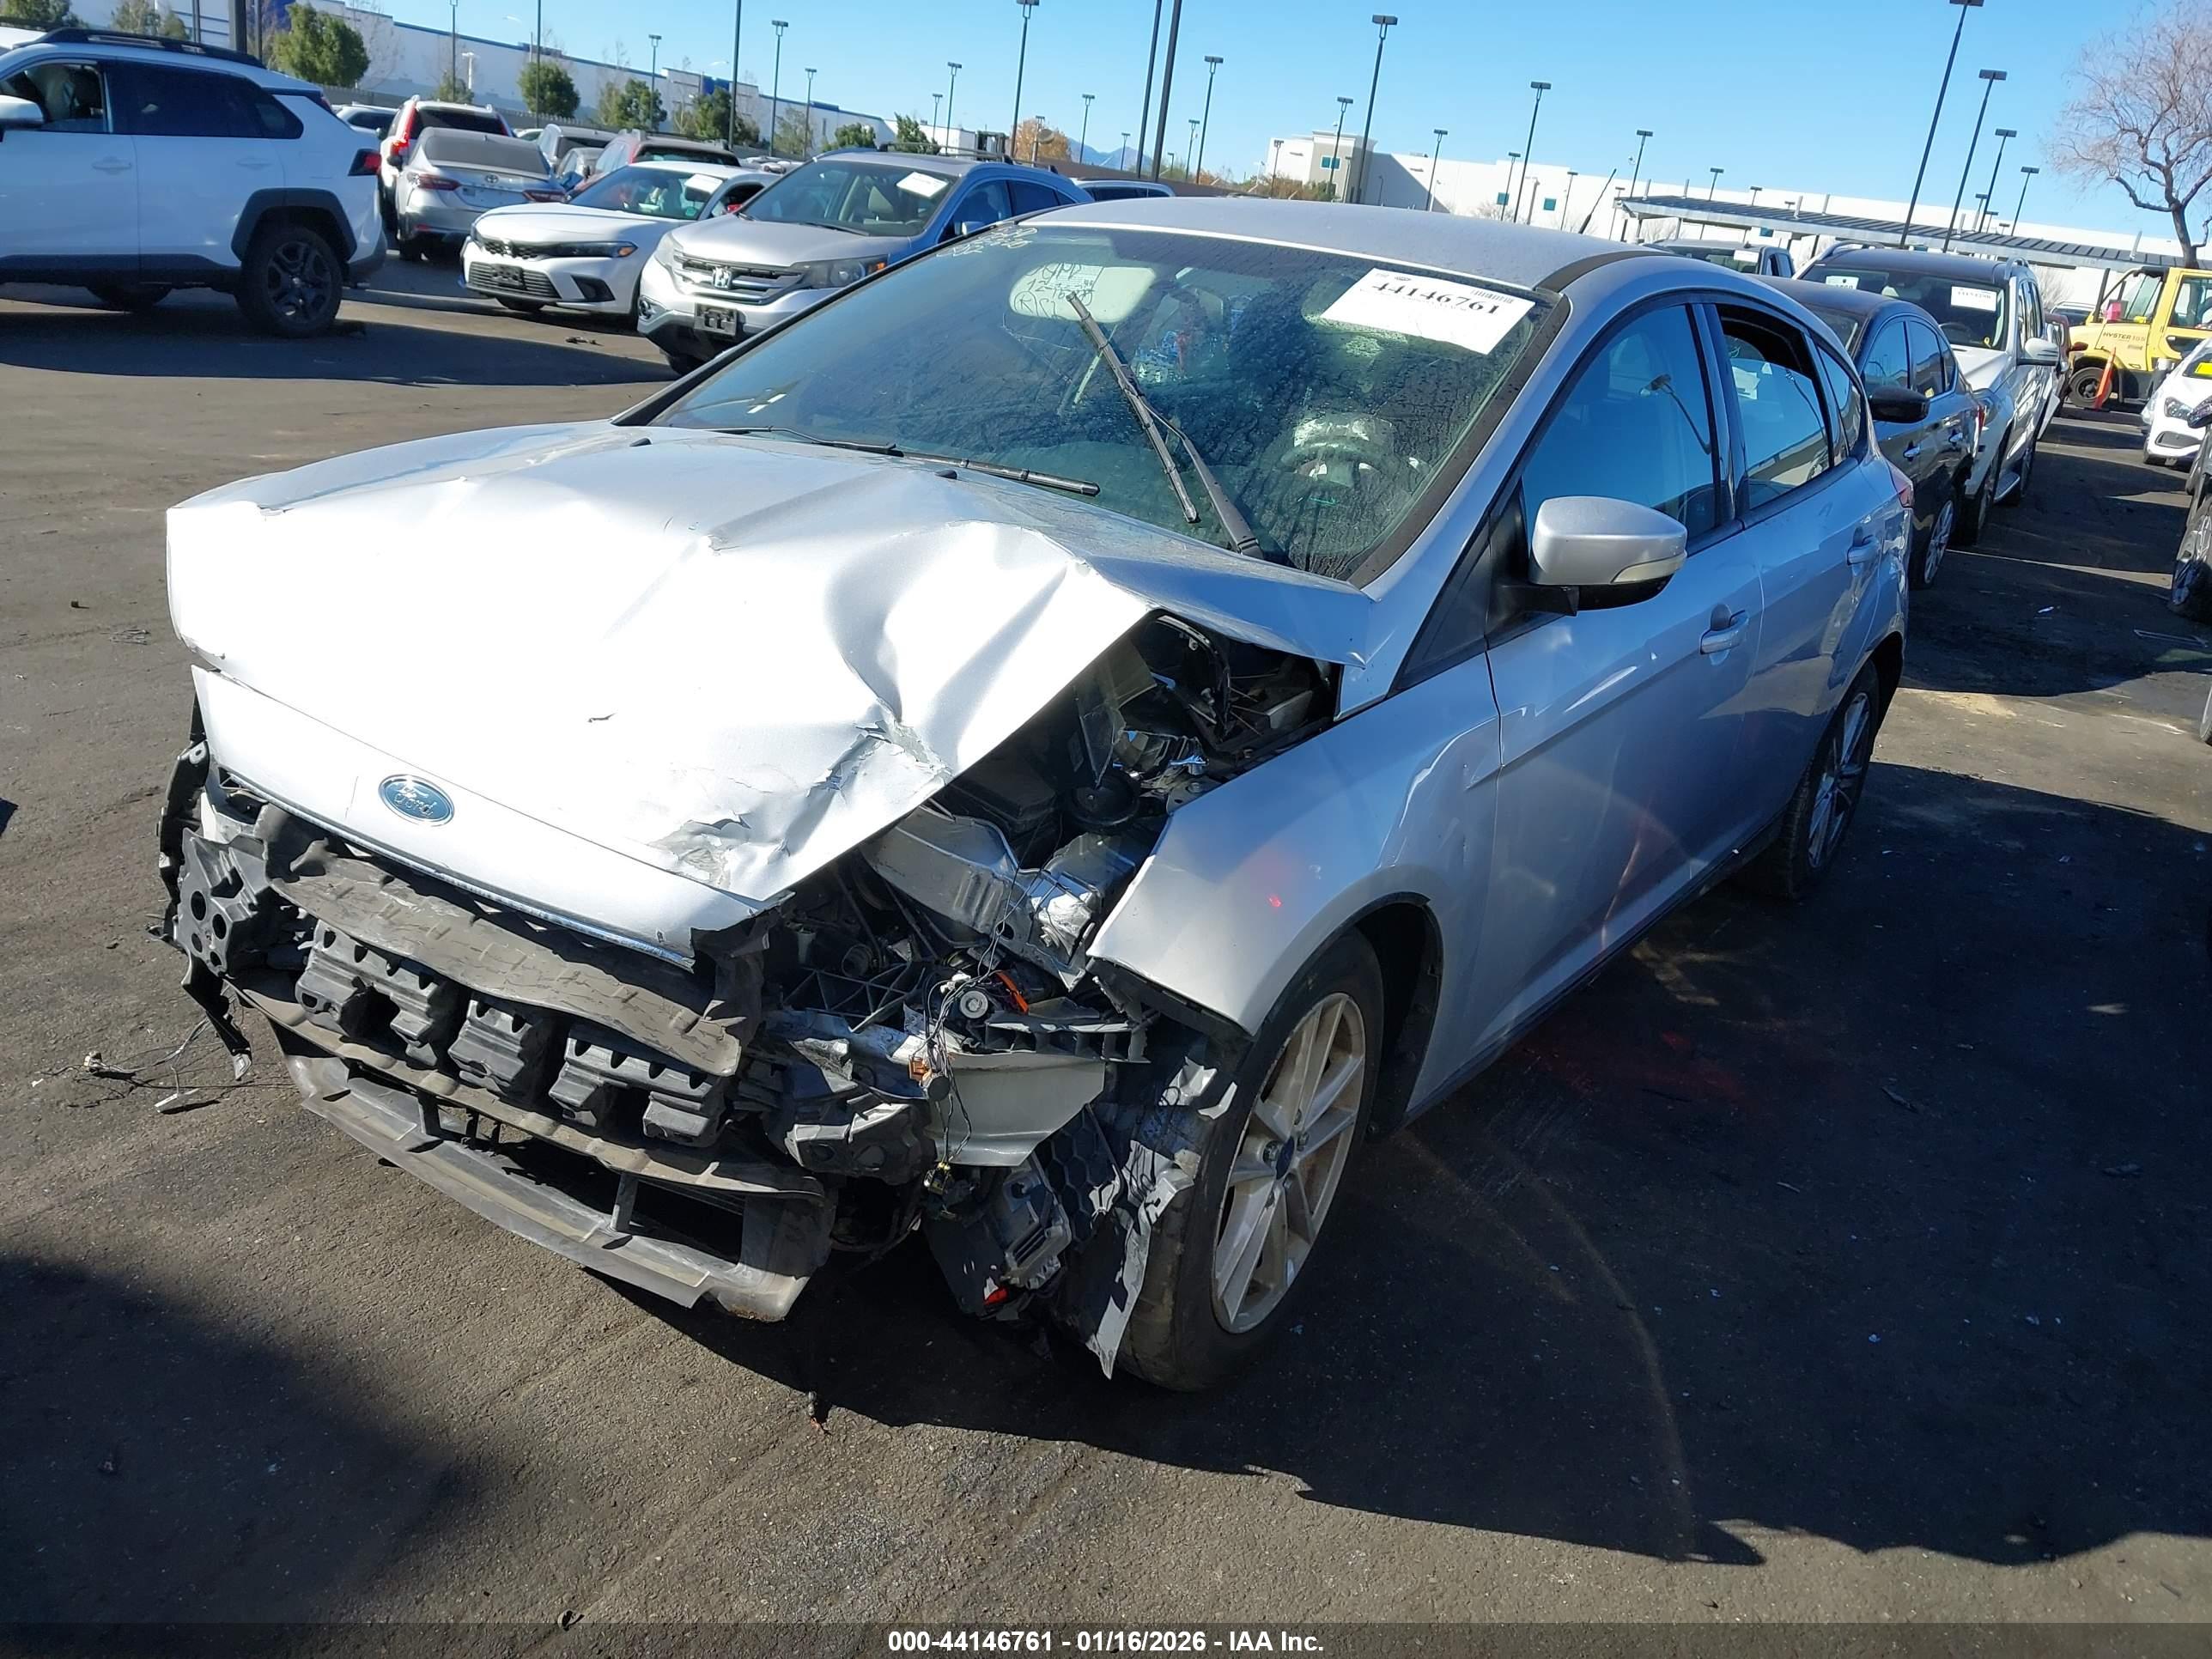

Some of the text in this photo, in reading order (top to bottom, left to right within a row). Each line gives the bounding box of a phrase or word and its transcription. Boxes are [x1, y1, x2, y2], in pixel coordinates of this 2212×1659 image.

[1371, 282, 1500, 315] 44146761
[2102, 331, 2131, 340] HYSTER
[393, 783, 438, 818] Ford
